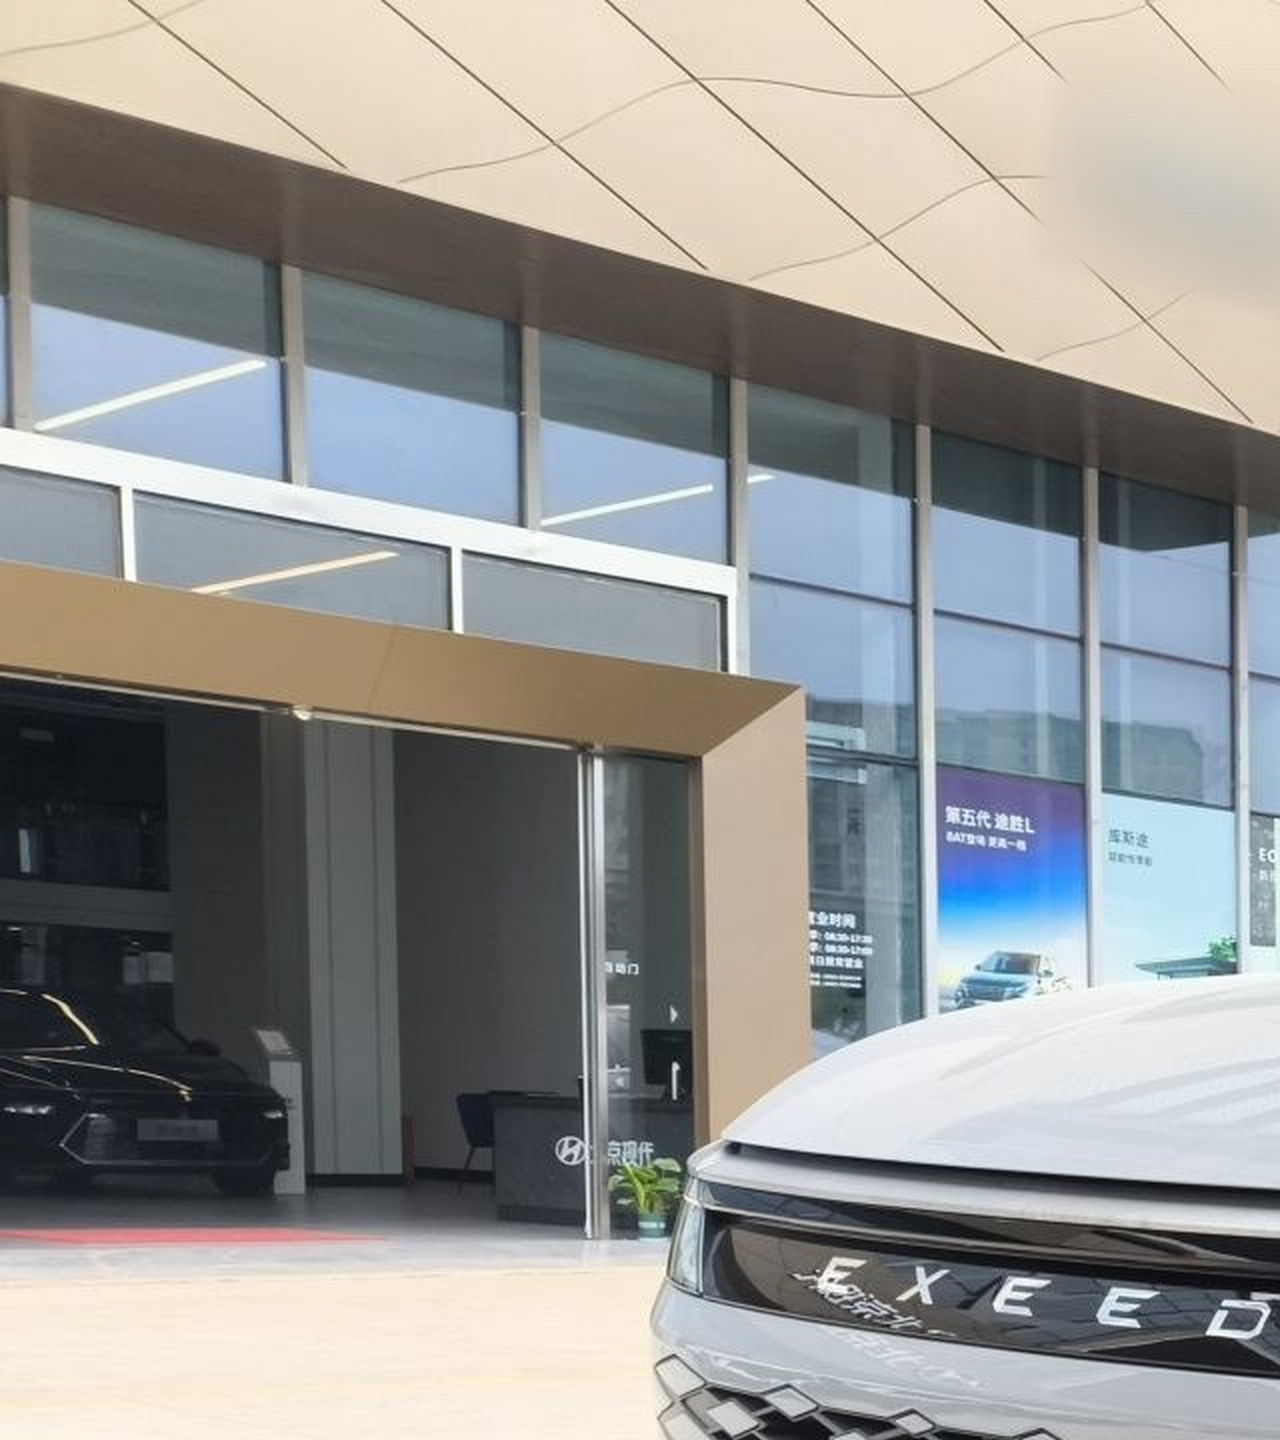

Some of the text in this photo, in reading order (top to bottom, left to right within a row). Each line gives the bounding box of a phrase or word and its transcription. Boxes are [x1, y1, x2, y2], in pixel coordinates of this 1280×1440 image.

[590, 1140, 654, 1167] 京现代
[817, 1256, 1271, 1340] EXEED
